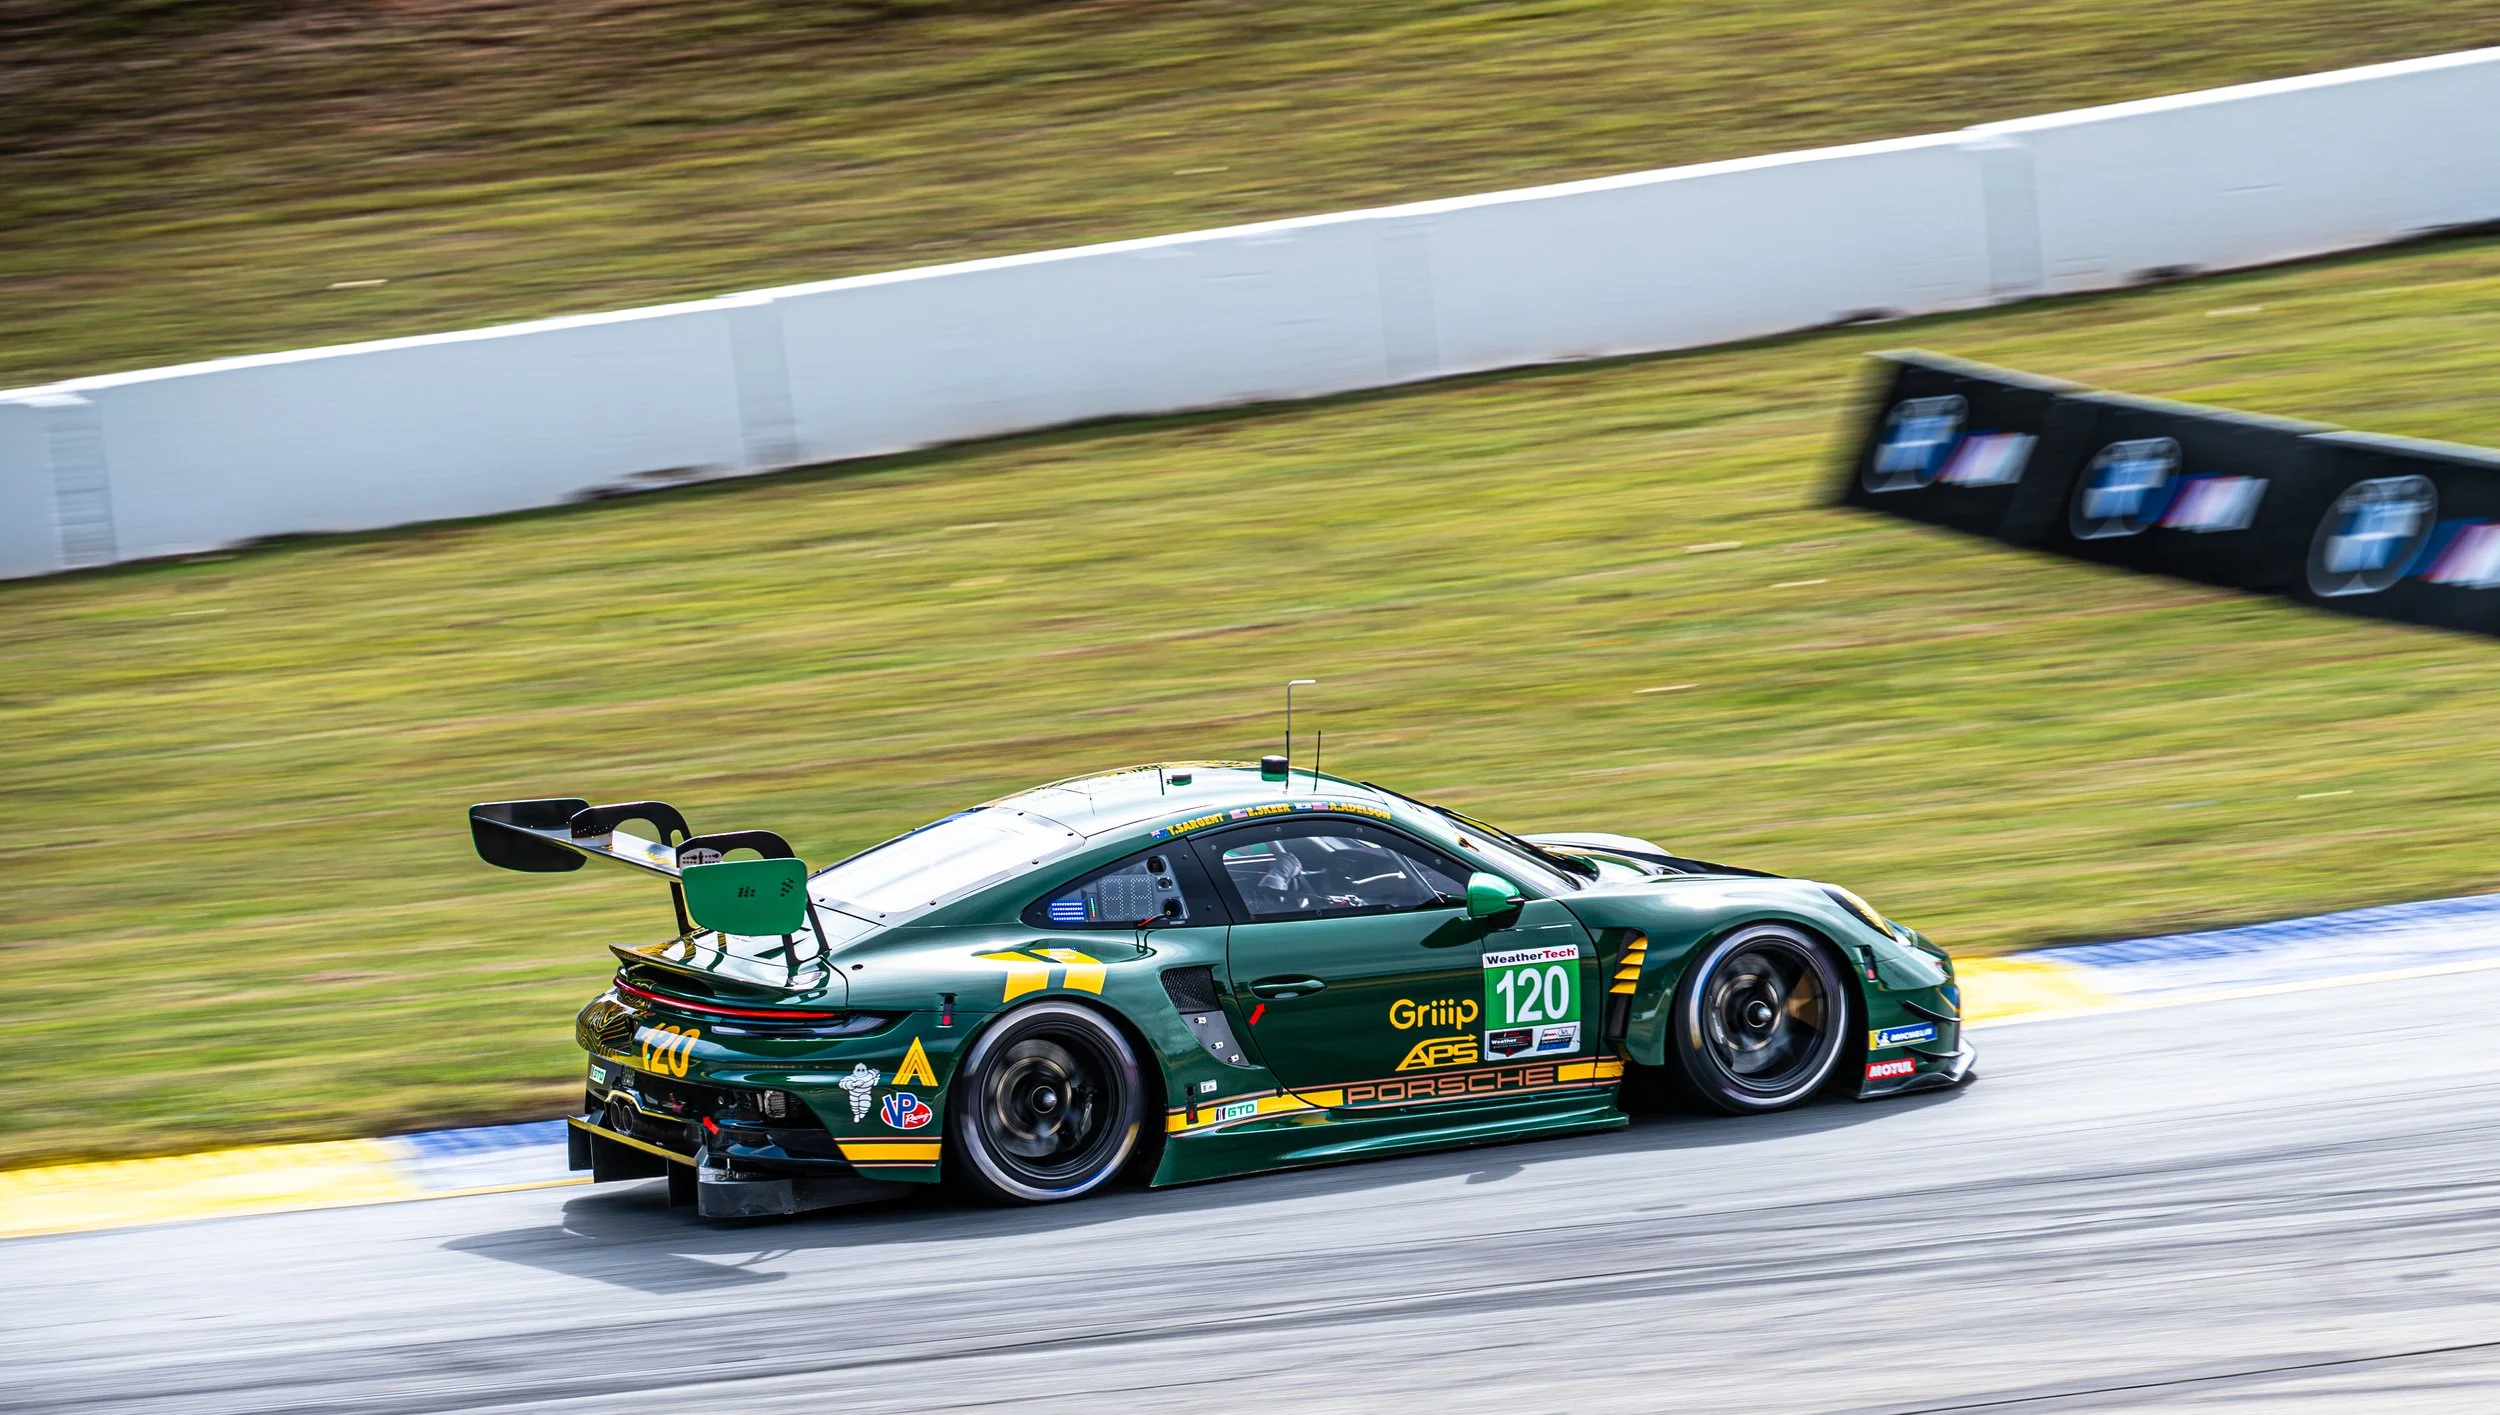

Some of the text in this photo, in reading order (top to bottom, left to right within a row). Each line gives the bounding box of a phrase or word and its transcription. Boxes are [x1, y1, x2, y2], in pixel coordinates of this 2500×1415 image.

[1166, 812, 1225, 836] T.SARGENT
[1328, 801, 1392, 820] A.ADELSON
[1496, 965, 1570, 1024] 120
[1389, 998, 1479, 1030] Griiip
[642, 1022, 701, 1078] 120
[1395, 1033, 1478, 1071] APS
[1347, 1066, 1555, 1105] PORSCHE
[1868, 1060, 1914, 1078] MOTUL
[881, 1092, 918, 1129] VP
[1227, 1103, 1256, 1118] GTD
